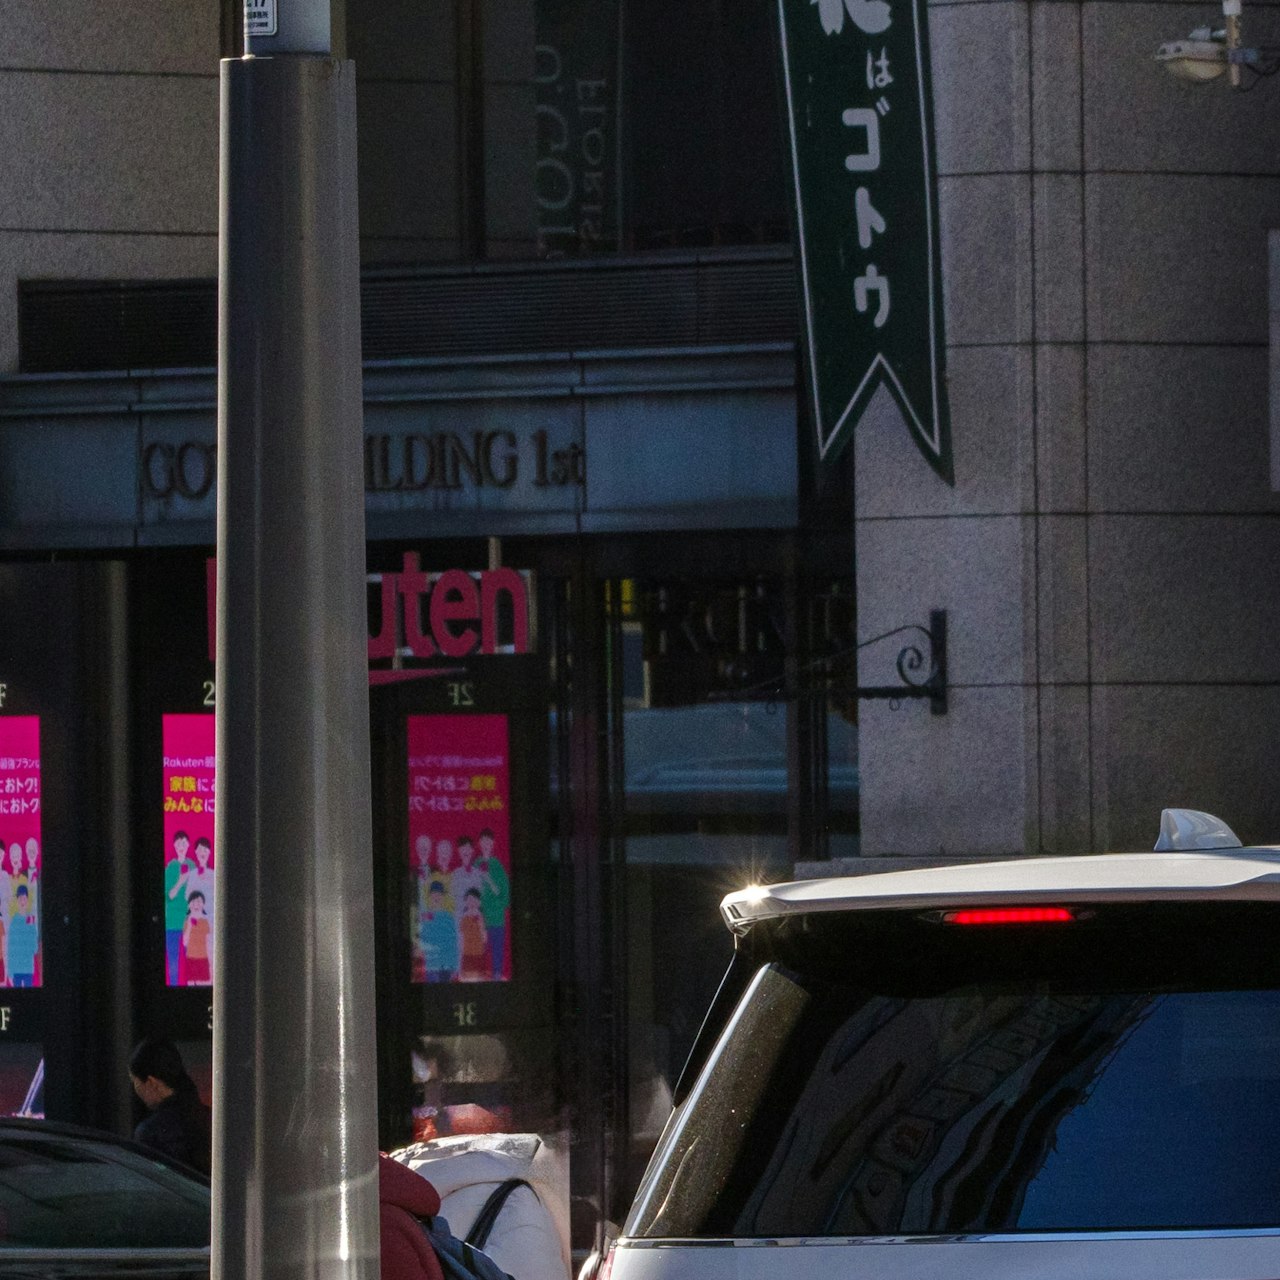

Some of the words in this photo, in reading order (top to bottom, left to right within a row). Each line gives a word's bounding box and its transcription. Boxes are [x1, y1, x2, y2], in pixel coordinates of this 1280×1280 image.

[143, 440, 217, 499] GO
[365, 428, 518, 491] ILDING
[531, 427, 586, 488] 1st
[203, 681, 217, 705] 2
